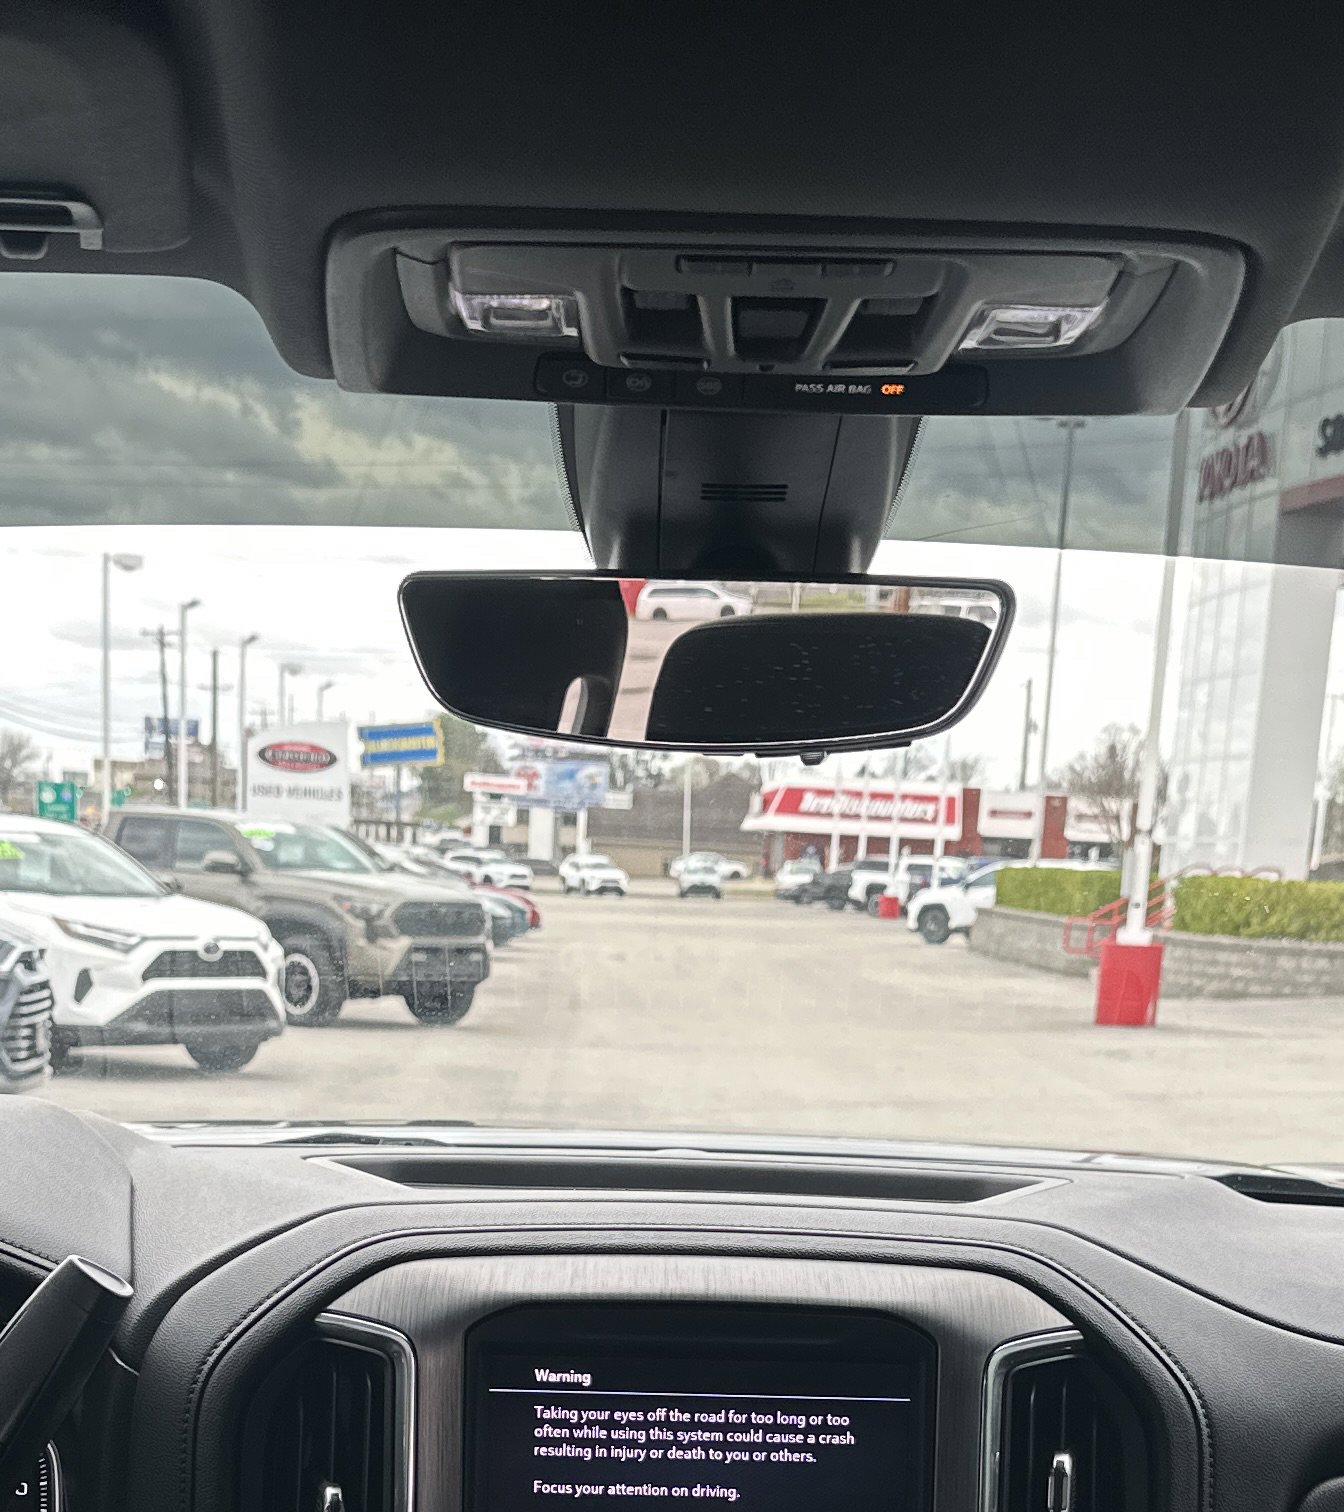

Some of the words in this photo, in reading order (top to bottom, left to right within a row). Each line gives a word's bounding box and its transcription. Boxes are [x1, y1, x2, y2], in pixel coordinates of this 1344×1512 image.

[795, 383, 824, 393] PASS
[826, 384, 846, 394] AIR
[848, 384, 872, 394] BAG
[881, 383, 906, 395] OFF
[533, 1368, 592, 1386] Warning
[533, 1406, 579, 1423] Taking
[579, 1411, 611, 1423] your
[613, 1411, 645, 1424] eyes
[646, 1408, 668, 1421] off
[668, 1409, 692, 1422] the
[694, 1410, 726, 1422] road
[727, 1410, 749, 1423] for
[749, 1412, 774, 1424] too
[776, 1411, 807, 1427] long
[808, 1416, 824, 1425] or
[825, 1414, 850, 1425] too
[533, 1424, 570, 1437] often
[571, 1425, 608, 1439] while
[610, 1426, 647, 1442] using
[648, 1427, 675, 1440] this
[676, 1430, 724, 1443] system
[726, 1429, 763, 1442] could
[765, 1433, 806, 1443] cause
[806, 1435, 816, 1443] a
[818, 1431, 855, 1444] crash
[533, 1443, 592, 1460] resulting
[594, 1445, 608, 1457] in
[610, 1445, 647, 1462] injury
[648, 1449, 665, 1458] or
[666, 1446, 706, 1459] death
[708, 1449, 724, 1460] to
[724, 1451, 750, 1463] you
[752, 1452, 768, 1461] or
[769, 1448, 817, 1462] others.
[533, 1480, 573, 1494] Focus
[574, 1485, 605, 1497] your
[606, 1484, 669, 1496] attention
[670, 1487, 689, 1496] on
[691, 1484, 741, 1501] driving.
